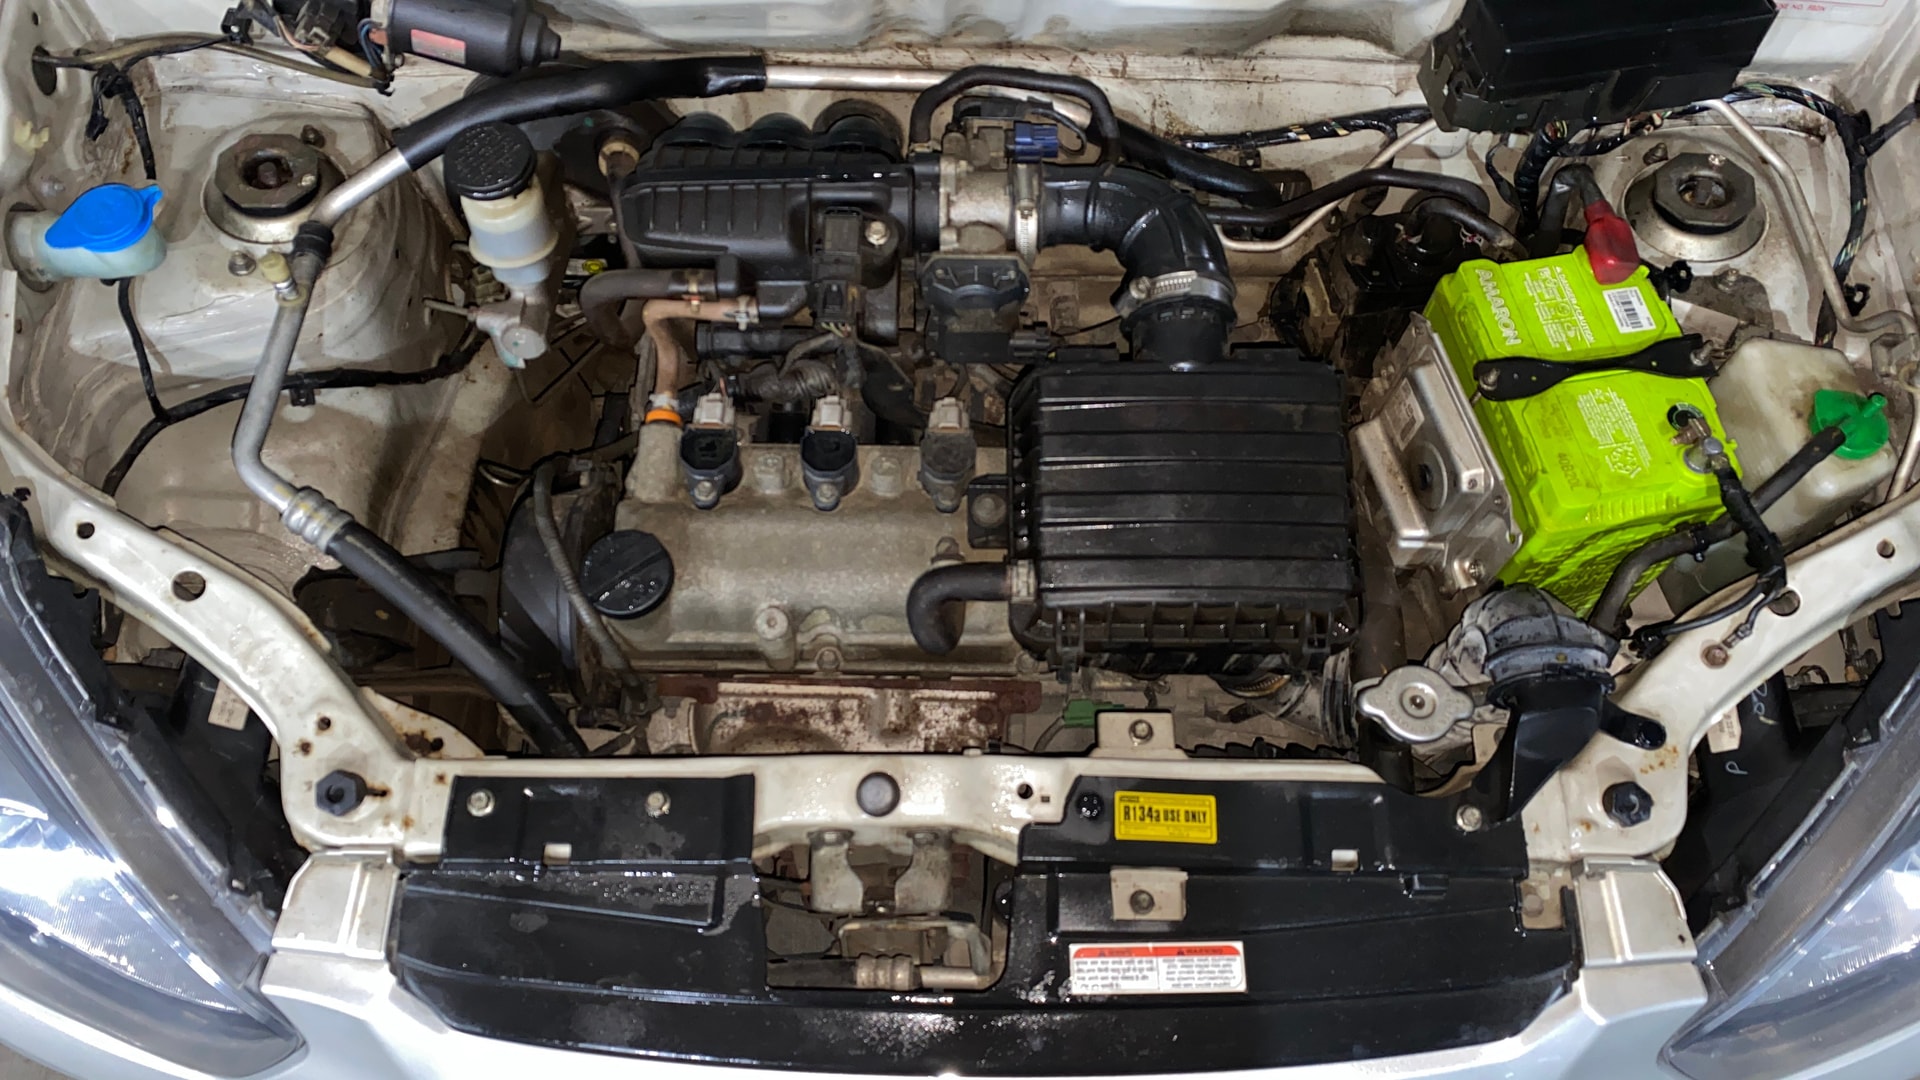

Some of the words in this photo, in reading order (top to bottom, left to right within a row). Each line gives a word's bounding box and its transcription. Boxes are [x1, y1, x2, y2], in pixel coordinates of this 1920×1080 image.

[1475, 268, 1522, 346] AMARON
[1123, 805, 1161, 824] R134a
[1162, 808, 1181, 823] USE
[1184, 809, 1207, 824] ONLY
